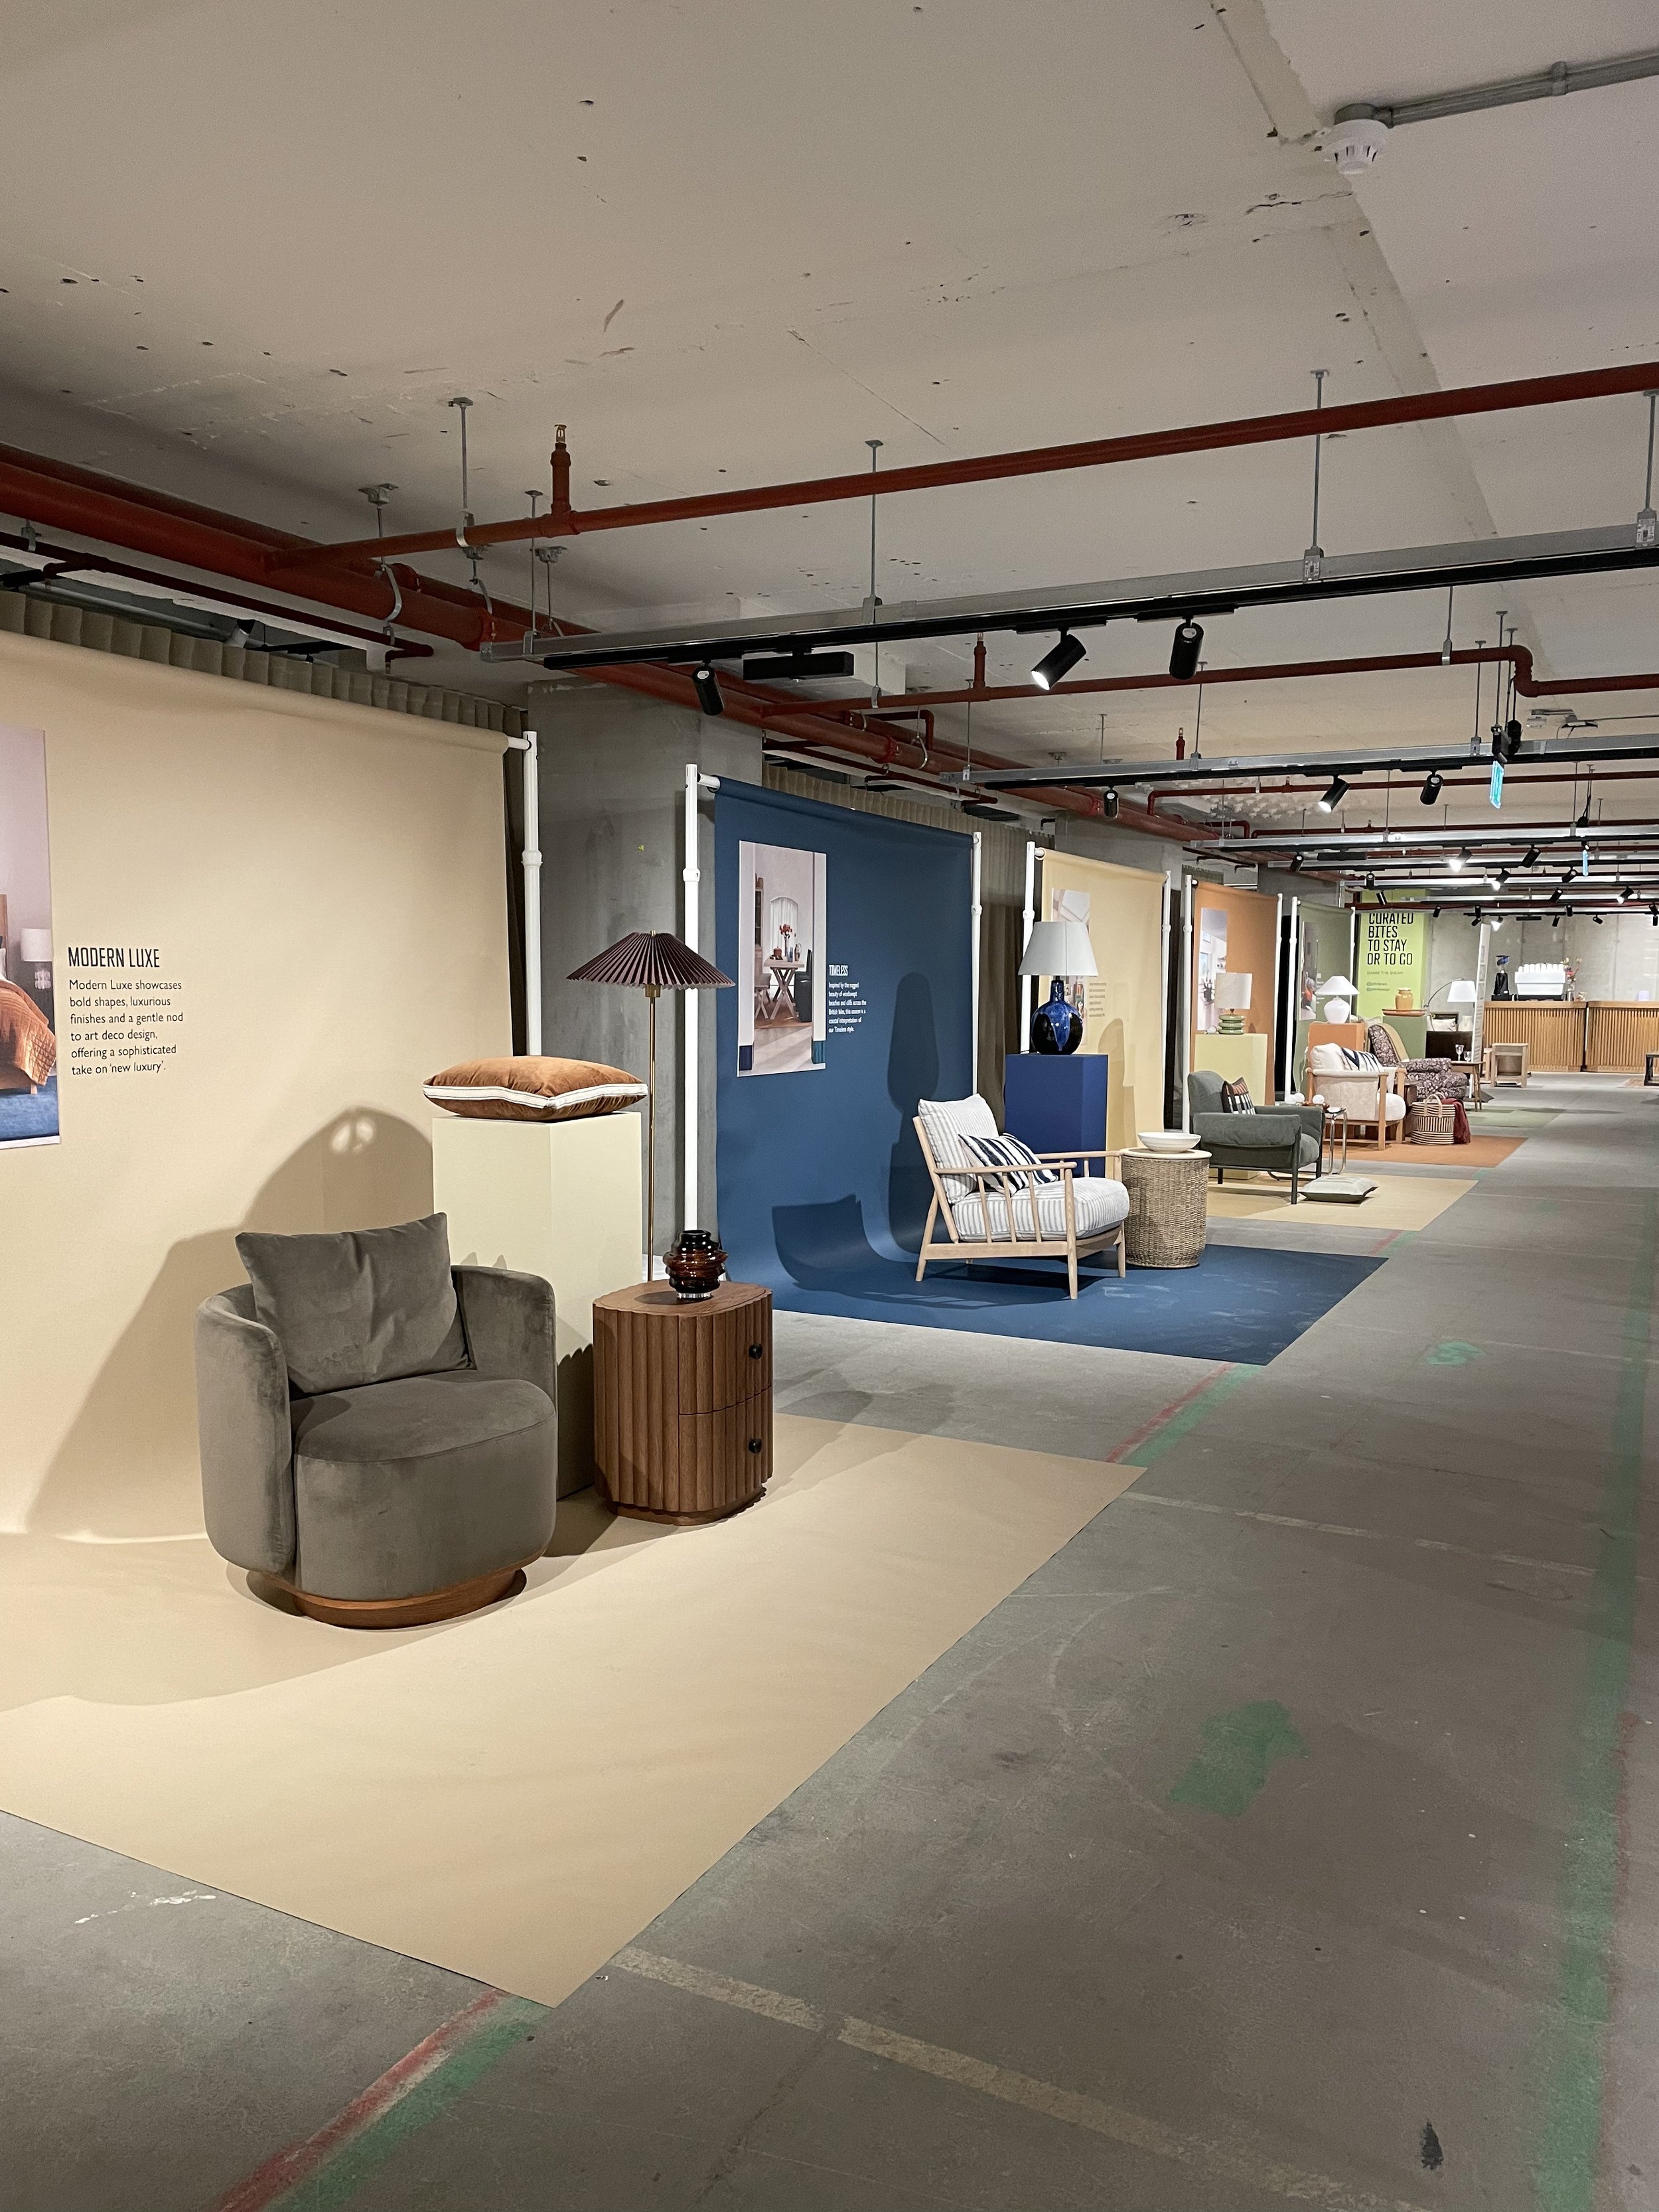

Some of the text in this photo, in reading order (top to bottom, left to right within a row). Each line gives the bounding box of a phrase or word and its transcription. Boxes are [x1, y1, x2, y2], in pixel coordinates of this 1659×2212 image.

[1368, 926, 1398, 938] BITES
[1368, 939, 1407, 951] TO STAY
[68, 947, 160, 968] MODERN LUXE
[1367, 953, 1413, 965] OR TO GO
[70, 980, 181, 990] Modern Luxe showcases
[70, 997, 171, 1009] bold shapes, luxurious
[70, 1013, 106, 1024] finishes
[109, 1013, 125, 1023] and
[136, 1013, 164, 1025] gentle
[167, 1012, 183, 1021] nod
[71, 1032, 81, 1041] to
[102, 1030, 124, 1040] deco
[127, 1029, 158, 1041] design,
[71, 1047, 107, 1060] offering
[118, 1045, 177, 1058] sophisticated
[72, 1065, 92, 1075] take
